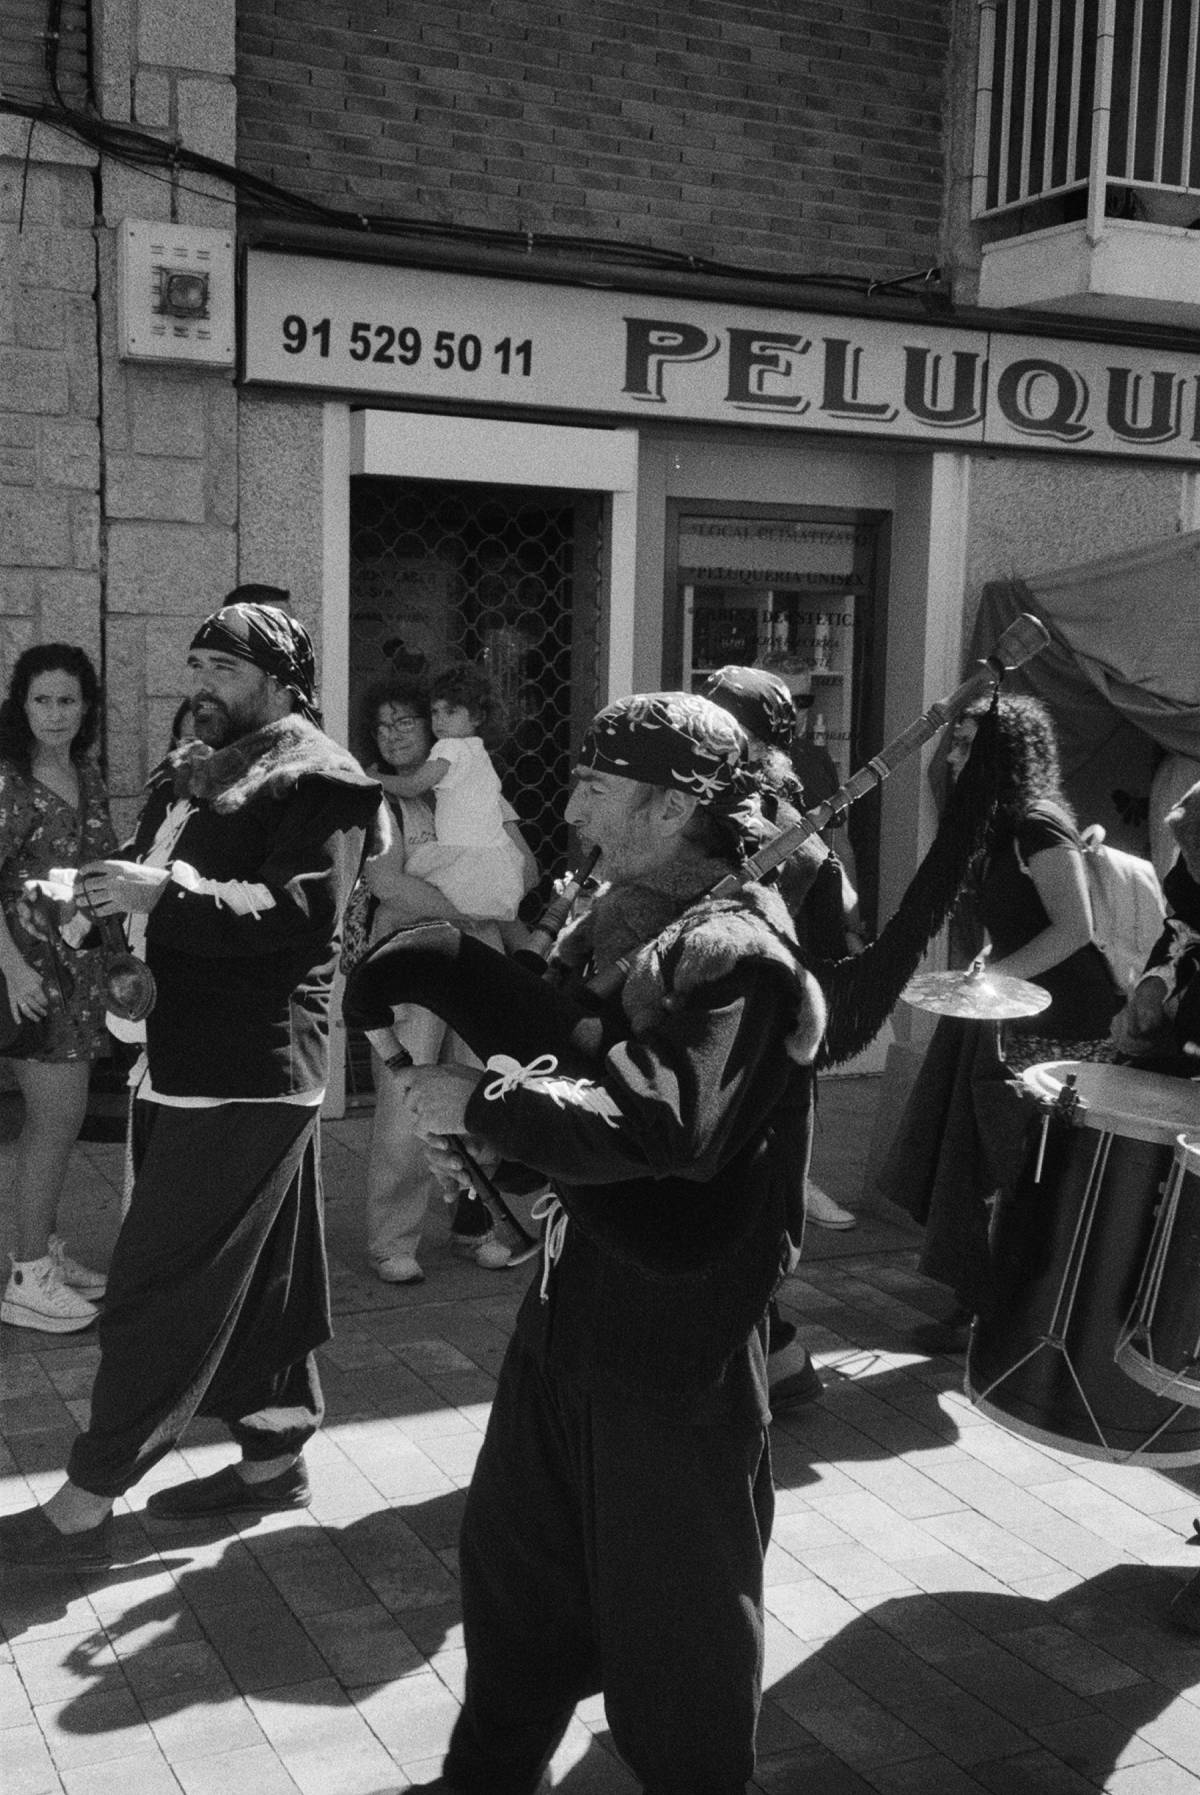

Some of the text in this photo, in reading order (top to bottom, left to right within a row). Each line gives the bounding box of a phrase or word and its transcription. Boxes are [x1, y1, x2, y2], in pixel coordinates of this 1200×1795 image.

[282, 314, 534, 377] 91 529 50 11
[620, 316, 1200, 448] PELUQU
